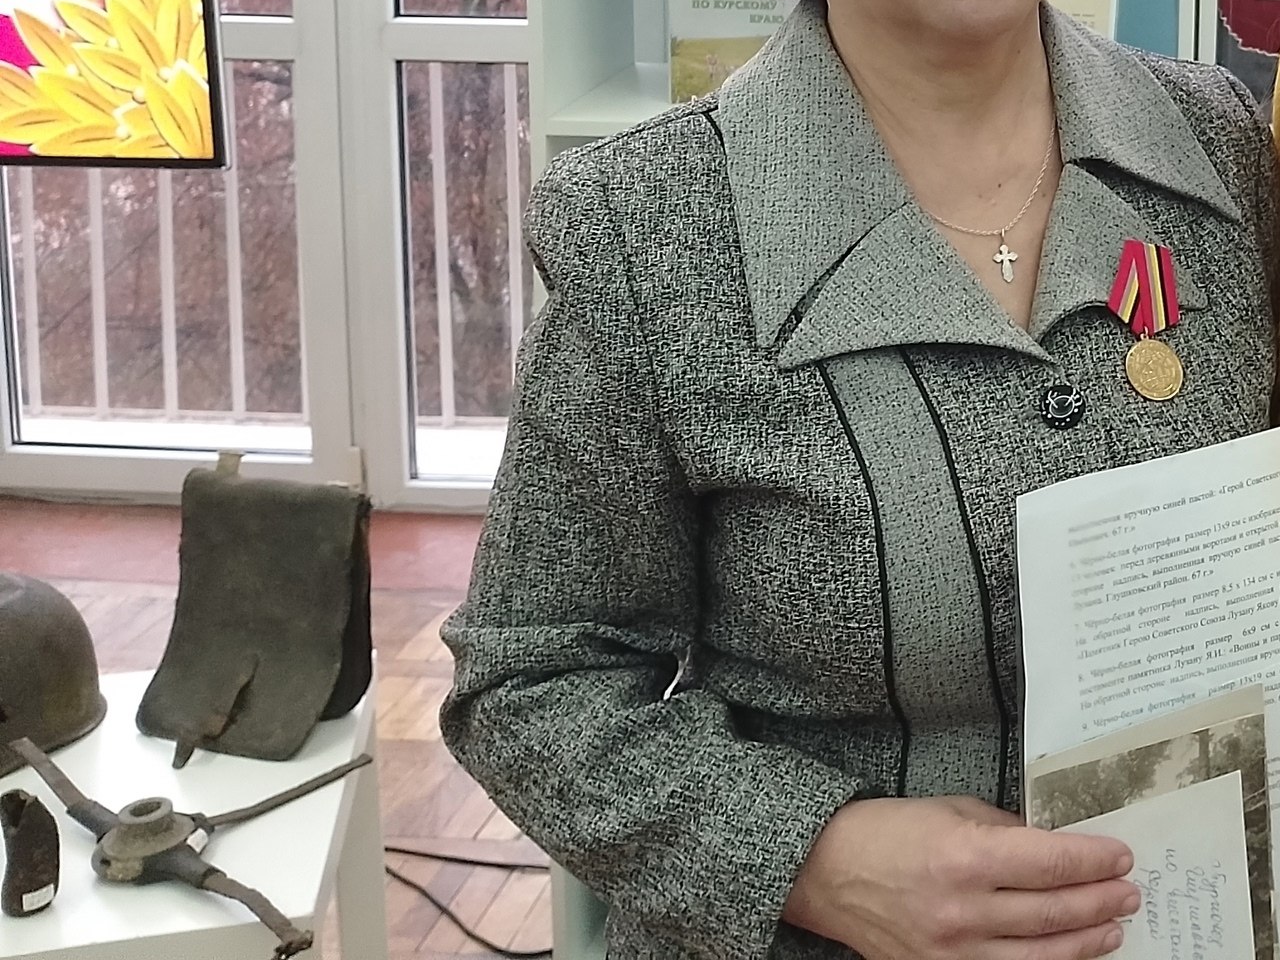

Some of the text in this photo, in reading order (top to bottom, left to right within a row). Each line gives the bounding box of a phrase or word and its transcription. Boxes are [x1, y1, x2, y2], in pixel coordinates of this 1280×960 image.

[692, 0, 778, 10] ПО КУРСКОМУ
[749, 14, 785, 24] КРАЮ
[1132, 535, 1181, 554] фотография
[1185, 528, 1212, 541] размер
[1106, 580, 1161, 602] Глушковский
[1137, 596, 1186, 616] фотография
[1192, 589, 1220, 603] размер
[1152, 619, 1199, 639] Советского
[1146, 643, 1195, 663] фотография
[1205, 634, 1233, 649] размер
